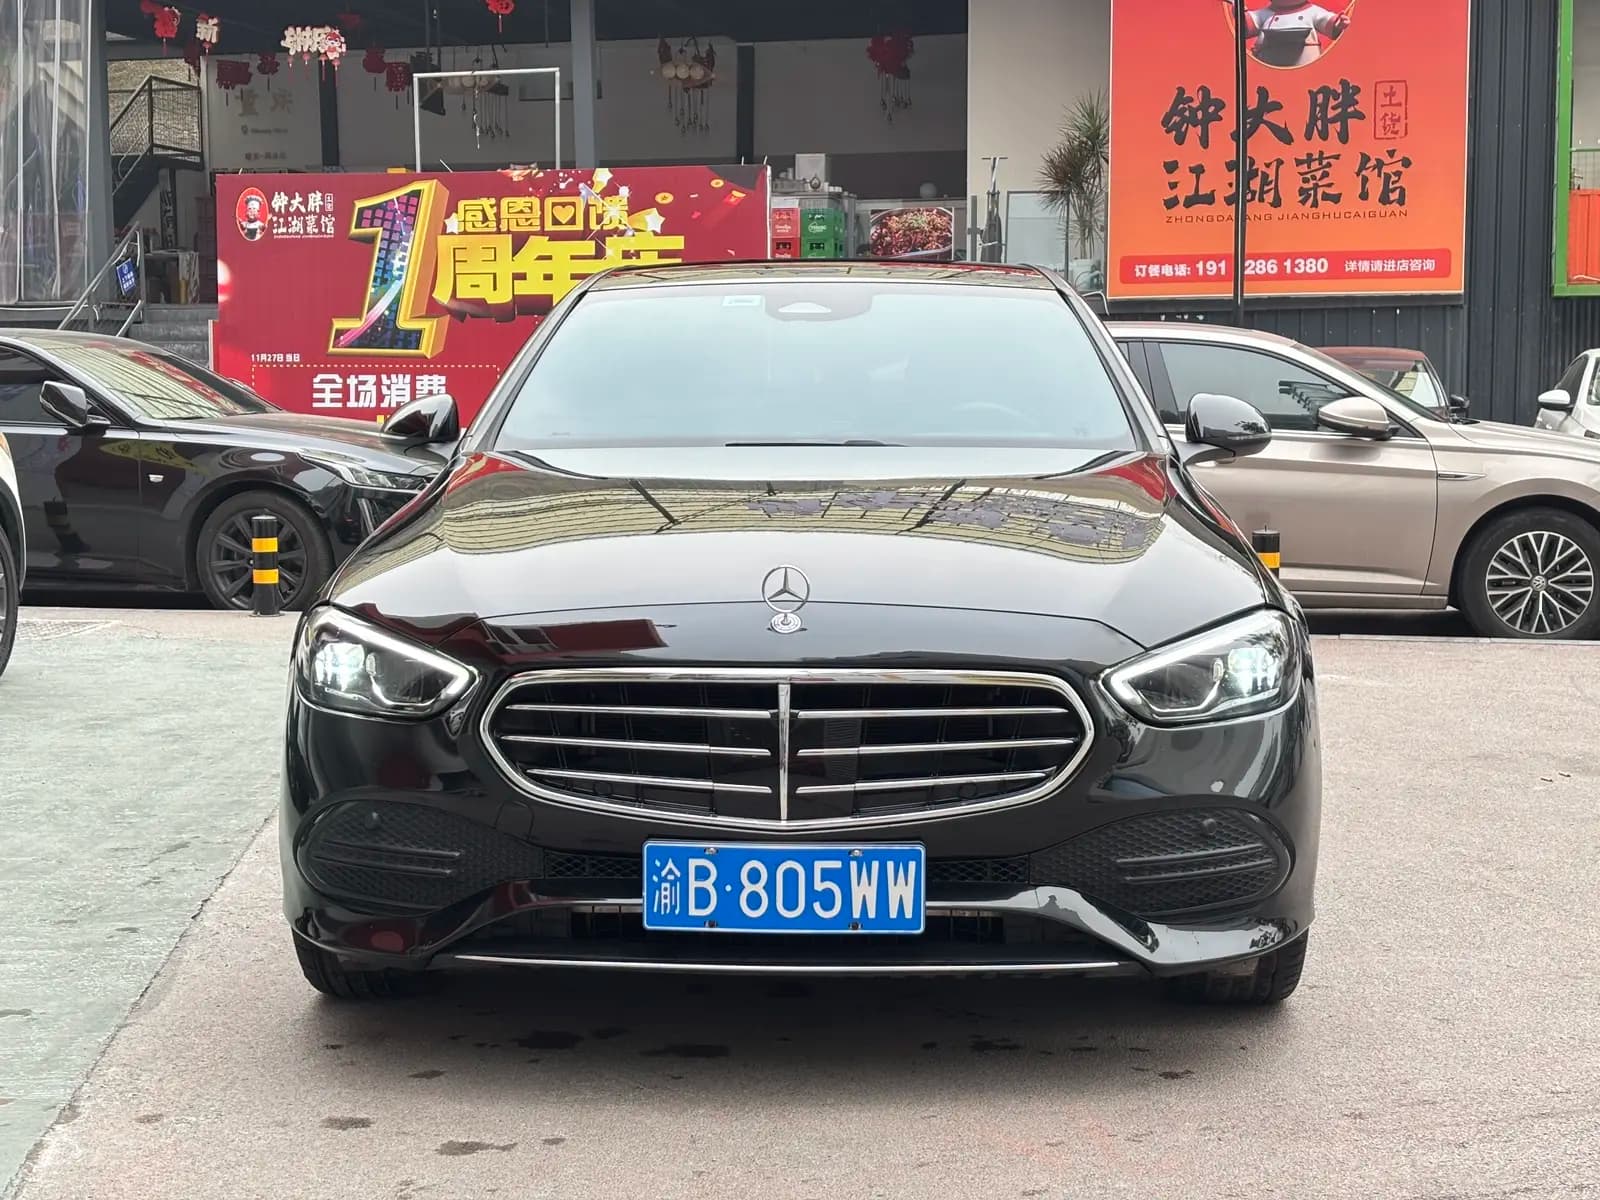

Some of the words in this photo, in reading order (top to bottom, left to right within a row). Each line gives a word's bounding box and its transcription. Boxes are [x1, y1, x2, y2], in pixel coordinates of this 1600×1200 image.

[1161, 78, 1366, 150] 钟大胖
[1162, 149, 1412, 210] 江湖菜馆
[271, 190, 324, 214] 钟大胖
[272, 214, 335, 234] 江湖菜馆
[1165, 213, 1273, 224] ZHONGDAANG
[1277, 209, 1408, 222] JIANGHUCAIGUAN
[1134, 264, 1191, 277] 订餐电话:
[1196, 260, 1226, 275] 191
[1238, 259, 1278, 275] 286
[1283, 258, 1328, 274] 1380
[1344, 258, 1435, 272] 详情请进店咨询
[653, 858, 916, 919] 渝B·805WW
